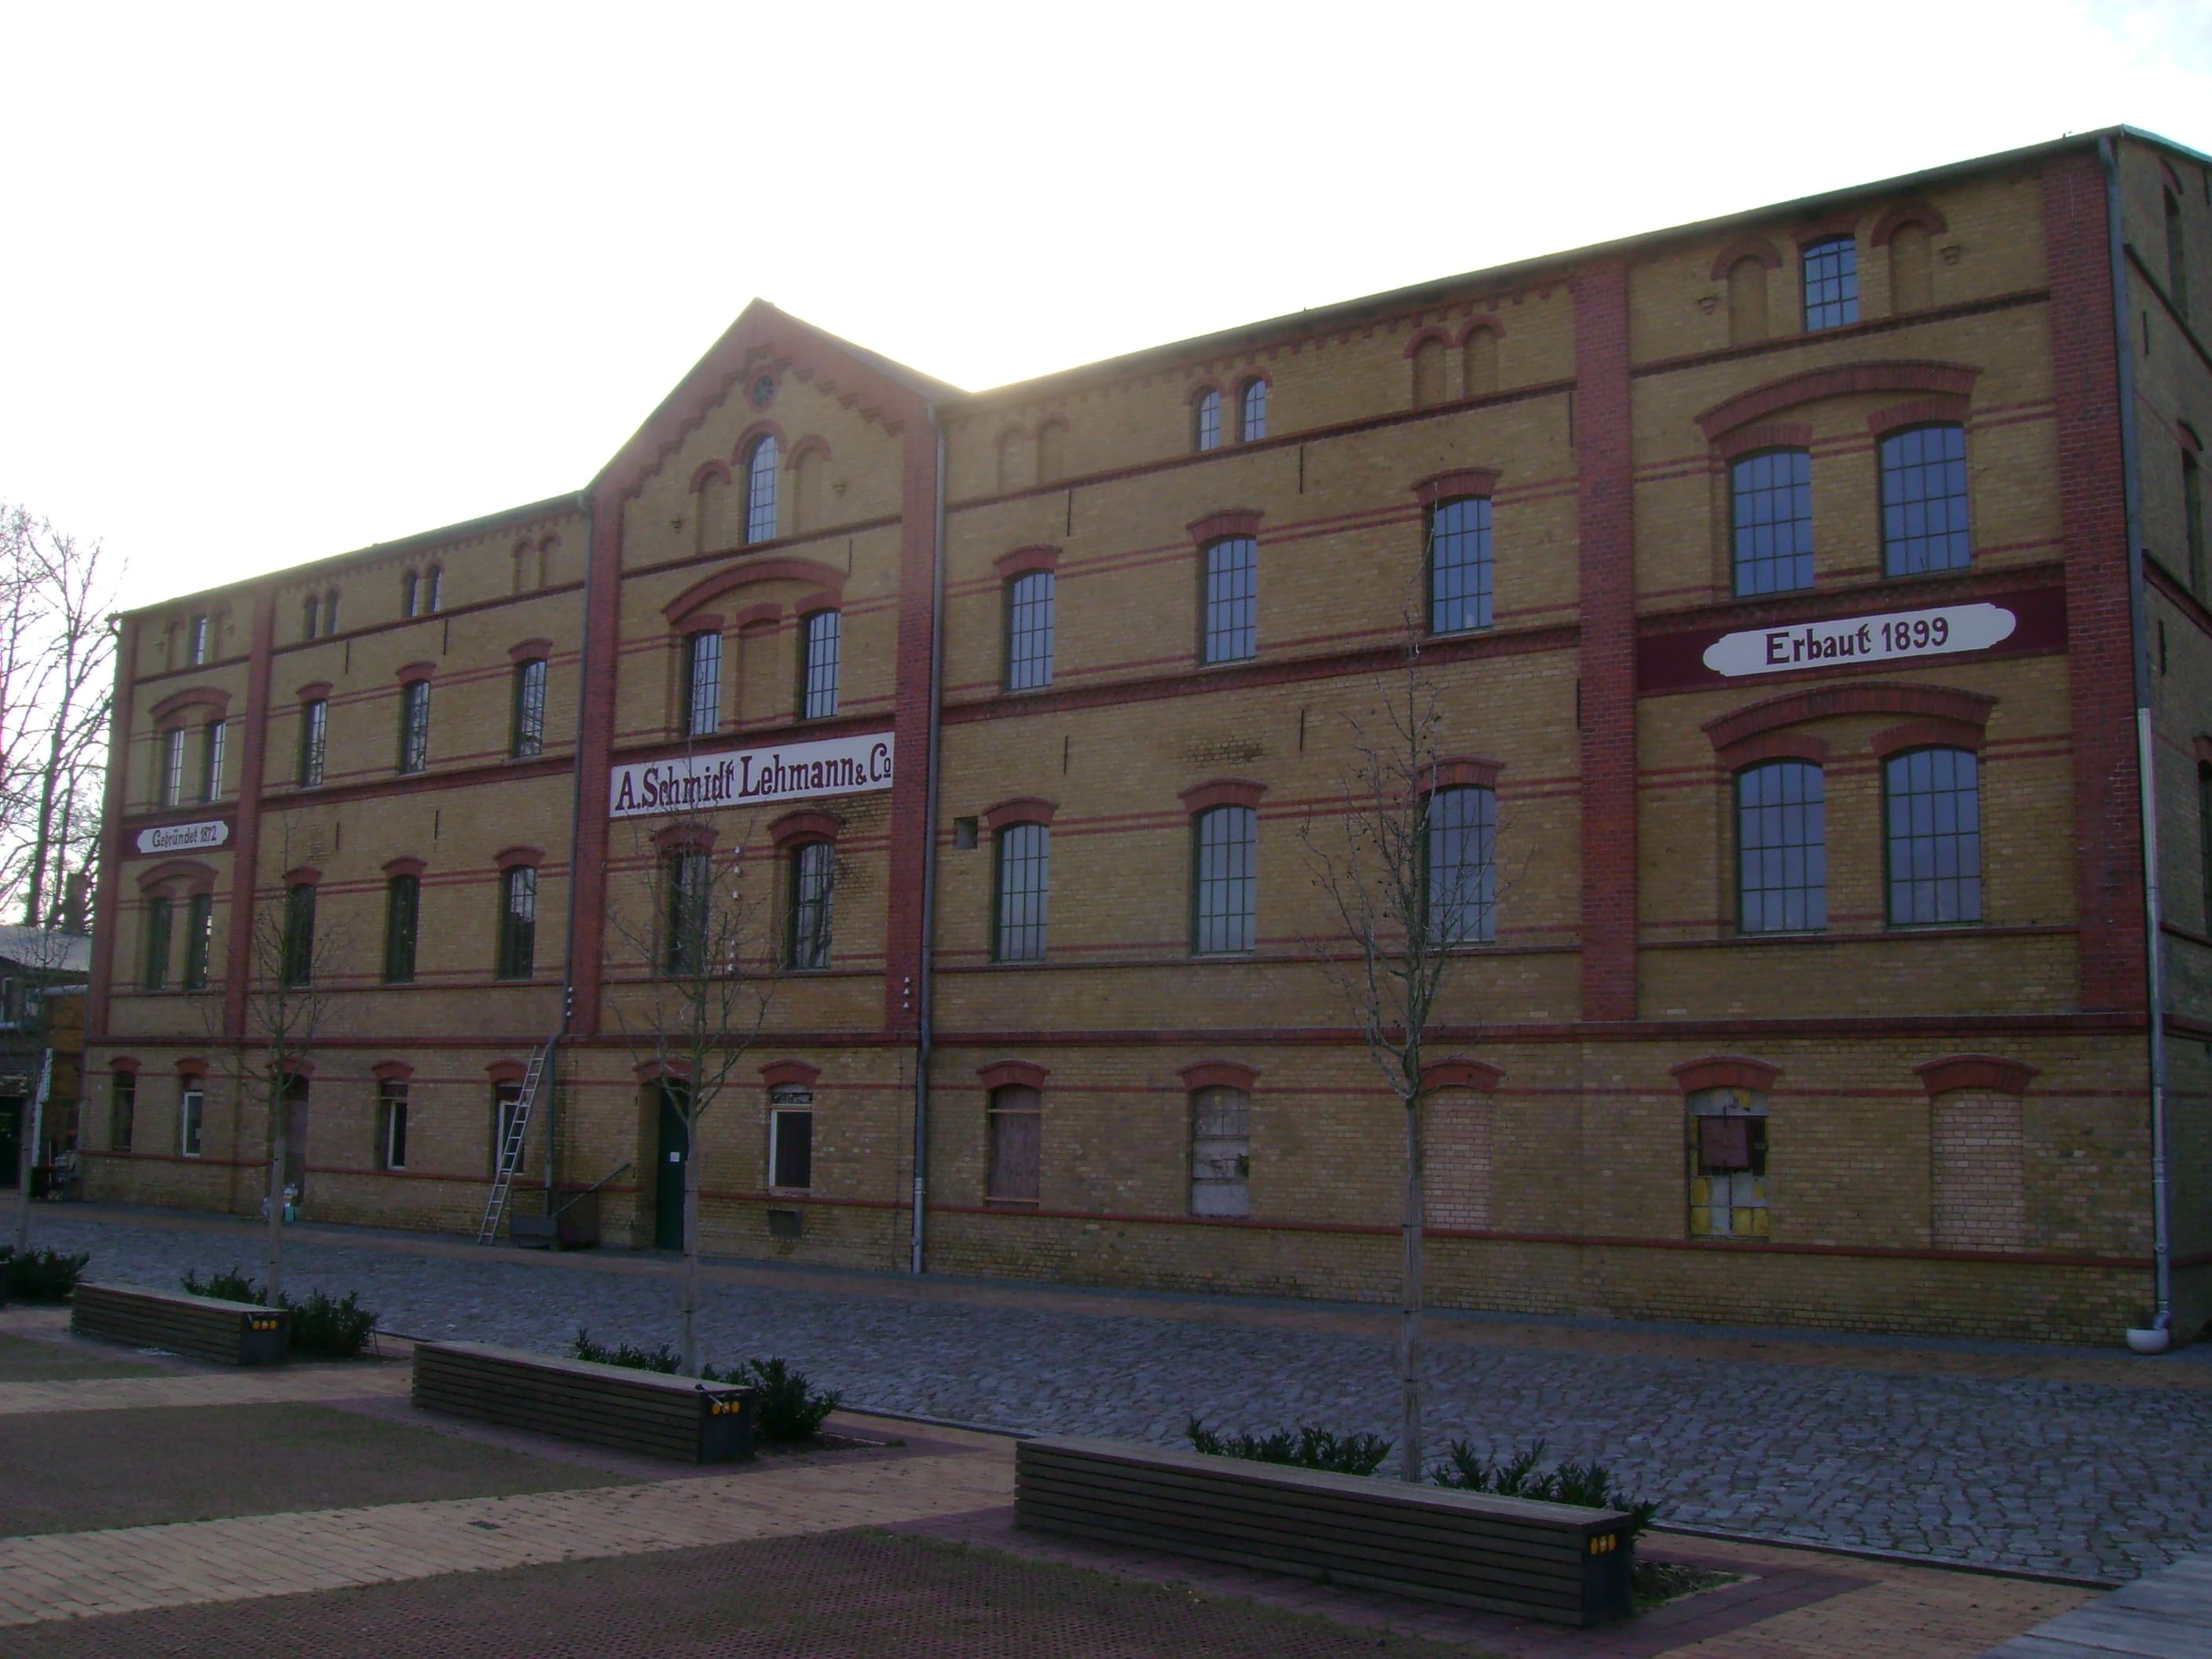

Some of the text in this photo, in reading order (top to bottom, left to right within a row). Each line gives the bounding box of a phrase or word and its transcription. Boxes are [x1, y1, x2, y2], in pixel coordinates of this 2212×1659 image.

[1766, 617, 1949, 665] Erbaut 1899
[152, 827, 198, 848] Gegründet
